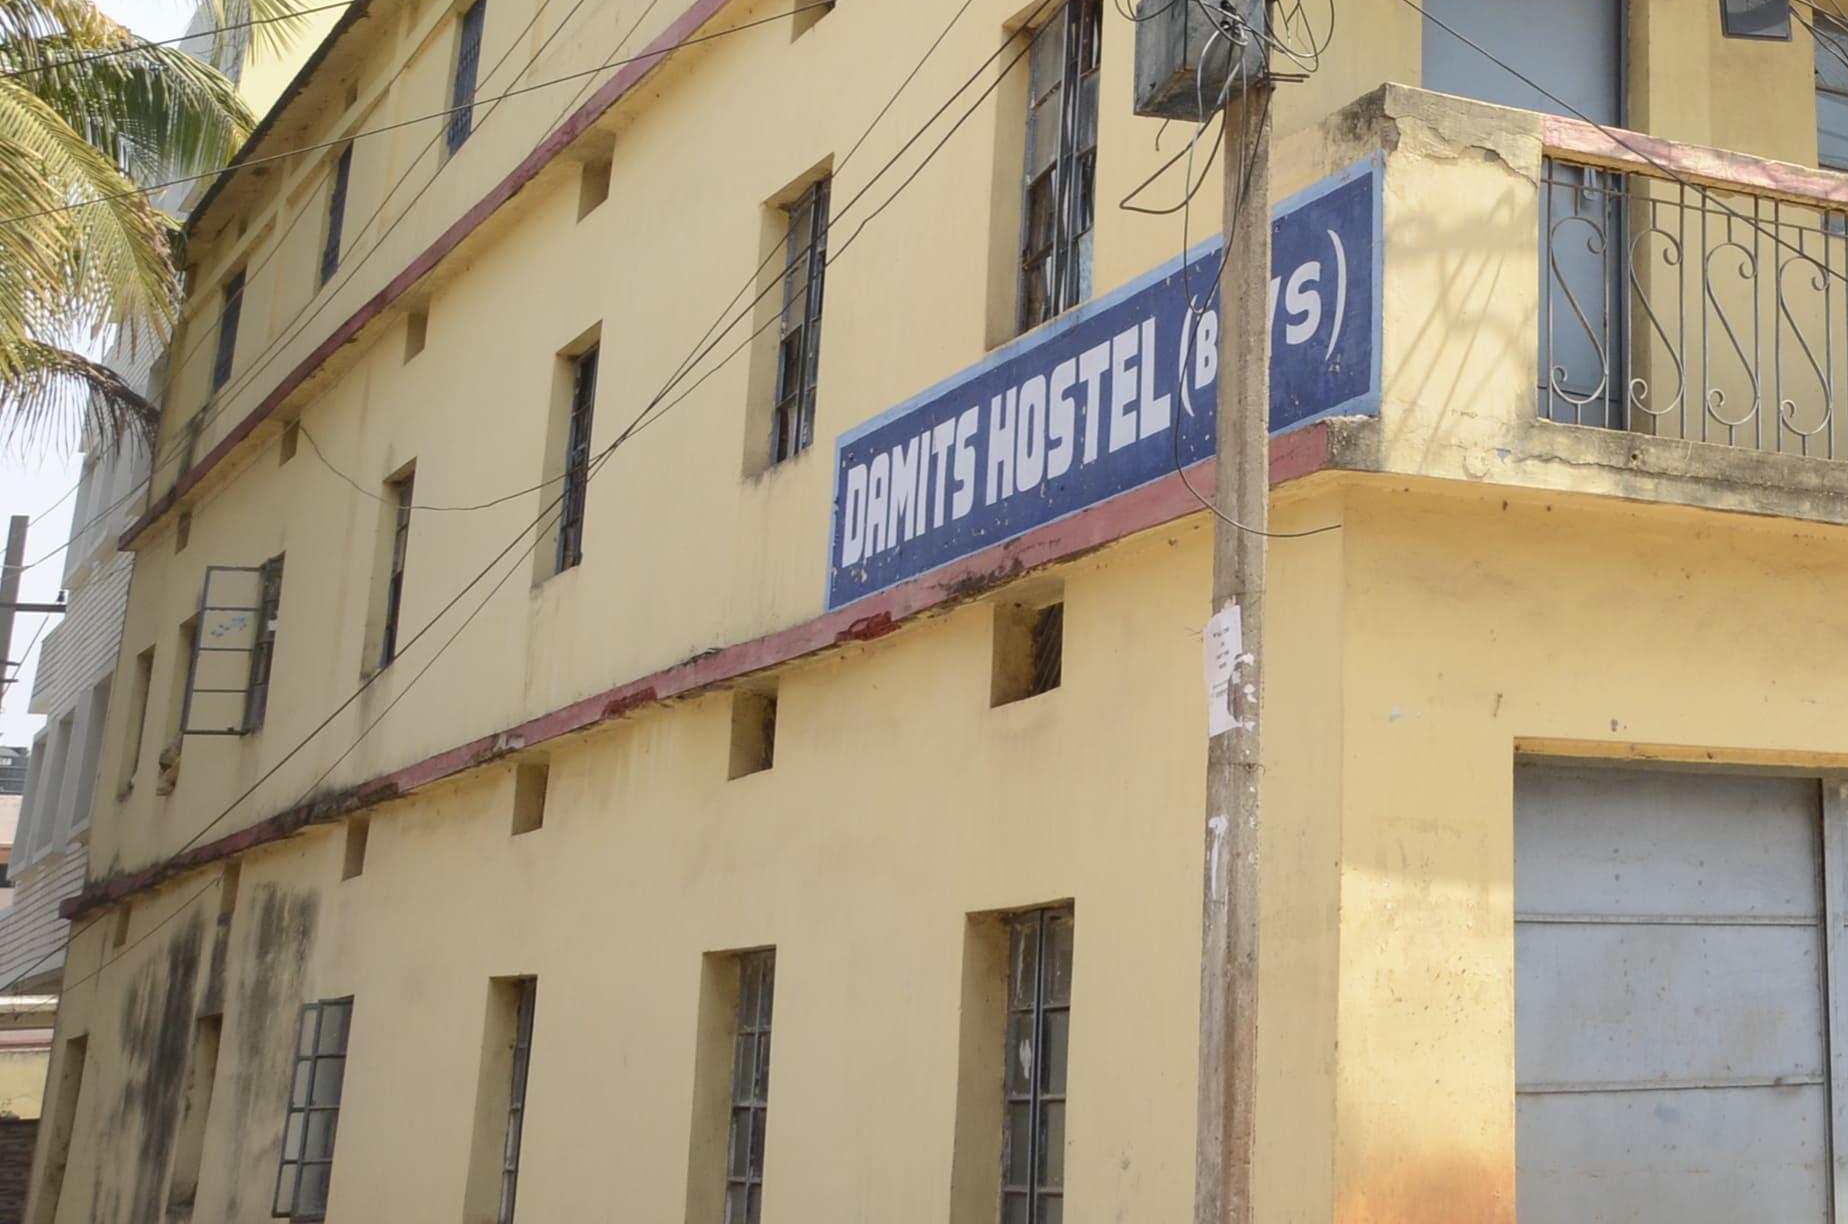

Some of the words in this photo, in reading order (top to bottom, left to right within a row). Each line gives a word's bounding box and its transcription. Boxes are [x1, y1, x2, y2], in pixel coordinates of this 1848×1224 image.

[841, 405, 979, 569] DAMITS
[985, 316, 1171, 507] HOSTEL
[1179, 229, 1347, 417] (BS)
